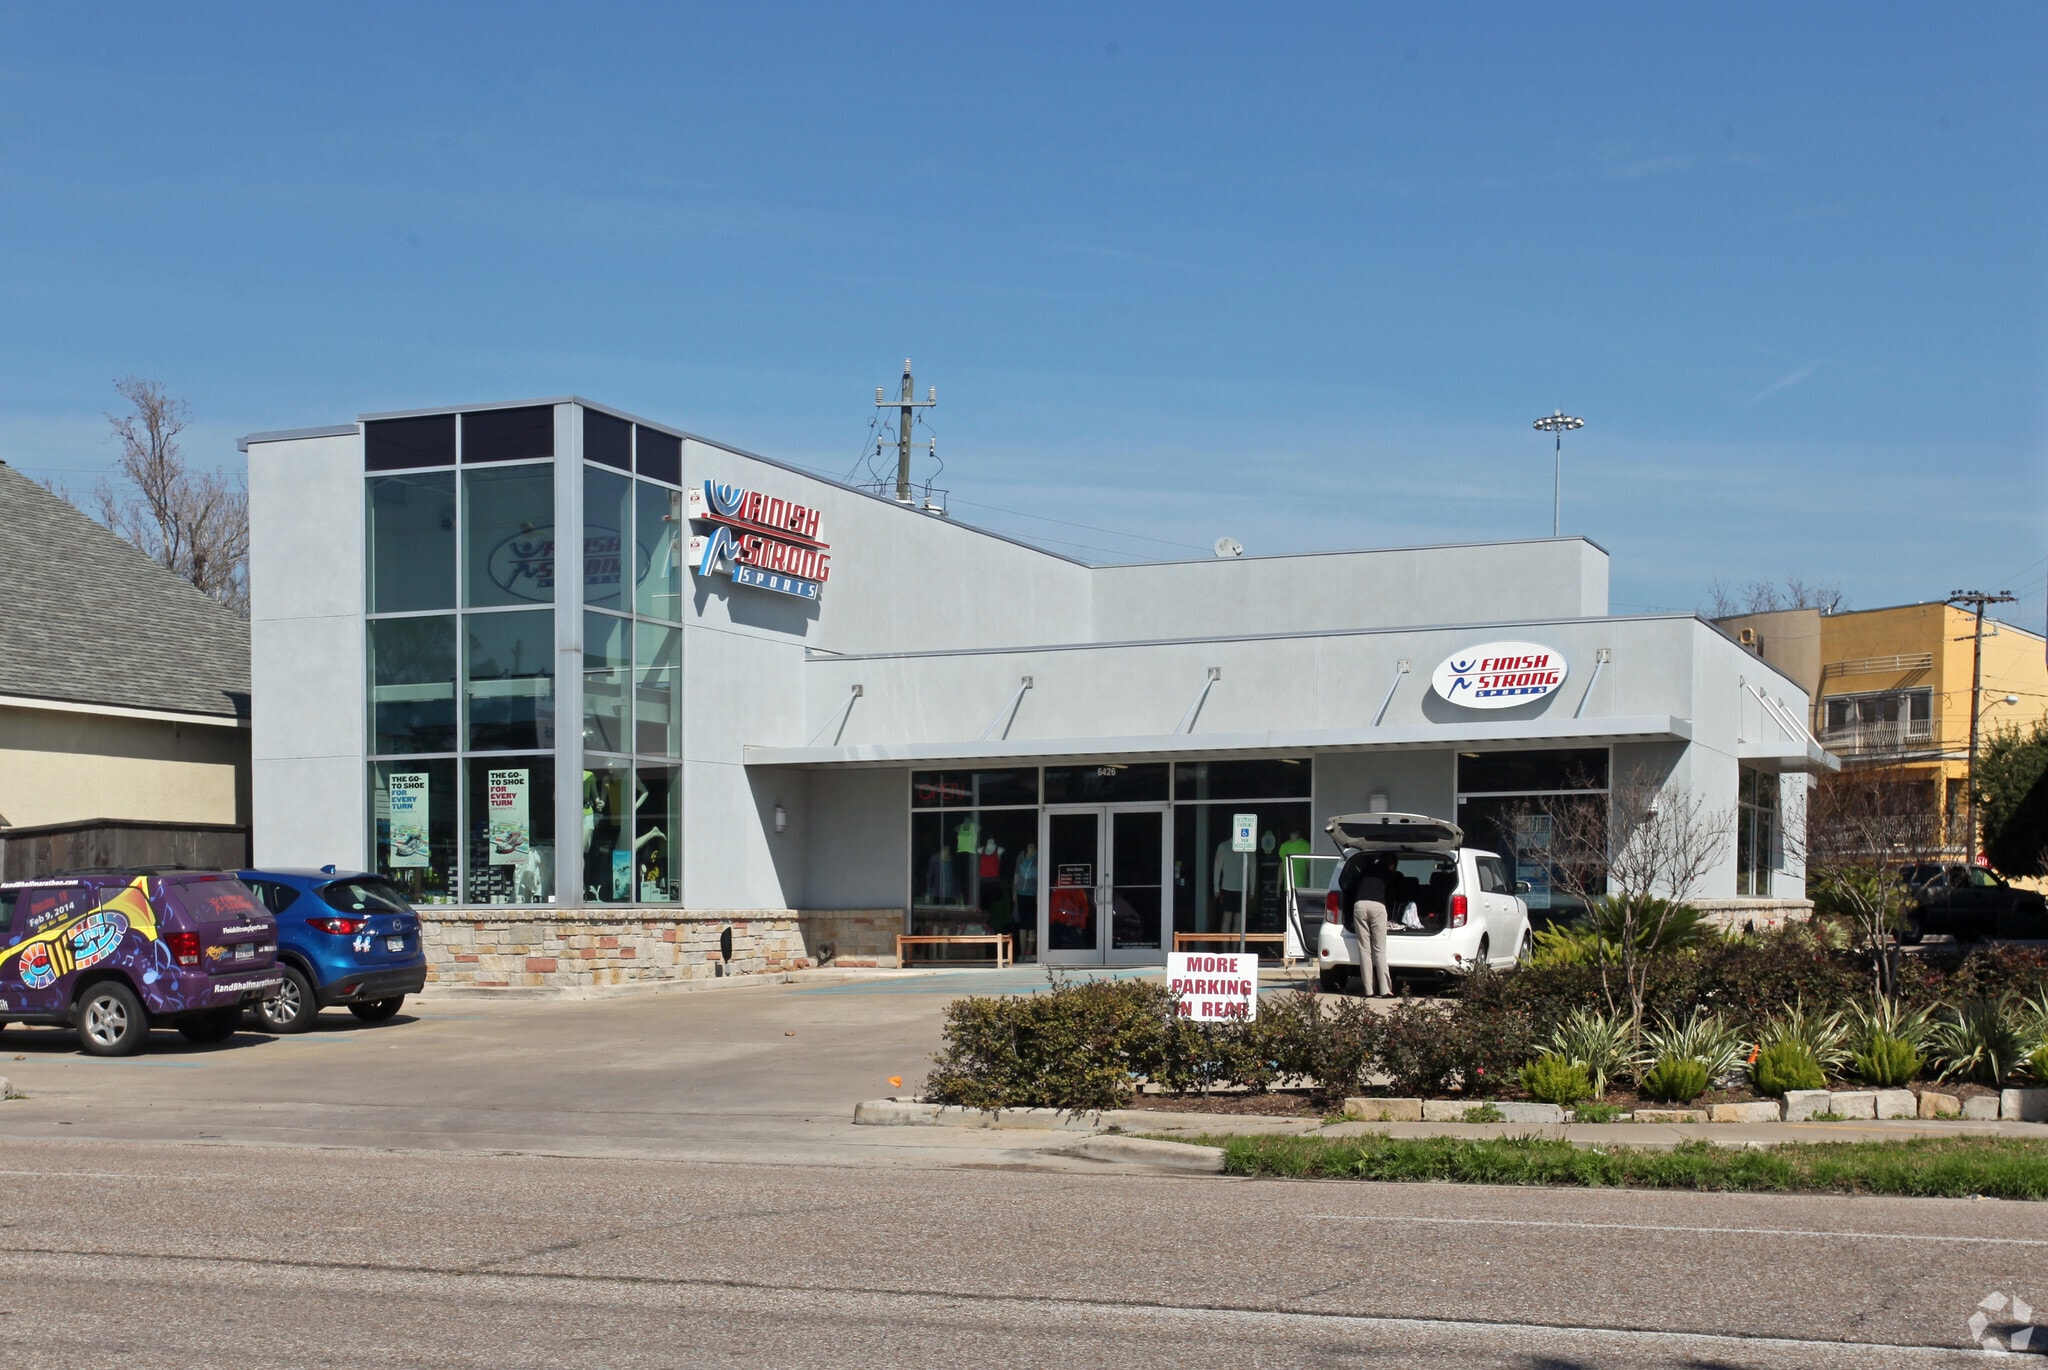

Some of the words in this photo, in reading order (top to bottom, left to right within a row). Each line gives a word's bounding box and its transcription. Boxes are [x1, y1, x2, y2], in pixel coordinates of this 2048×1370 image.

[740, 491, 822, 537] FINISH
[736, 534, 831, 582] STRONG
[742, 569, 816, 597] SPORTS
[1480, 655, 1549, 671] FINISH
[1477, 672, 1559, 688] STRONG
[1478, 687, 1545, 697] SPORTS
[1097, 767, 1116, 776] 6426
[919, 783, 965, 800] OPEN
[29, 915, 45, 927] Feb
[45, 912, 54, 920] 9,
[54, 901, 75, 916] 2014
[1186, 957, 1238, 973] MORE
[1171, 979, 1252, 995] PARKING
[1201, 1001, 1249, 1018] REAR
